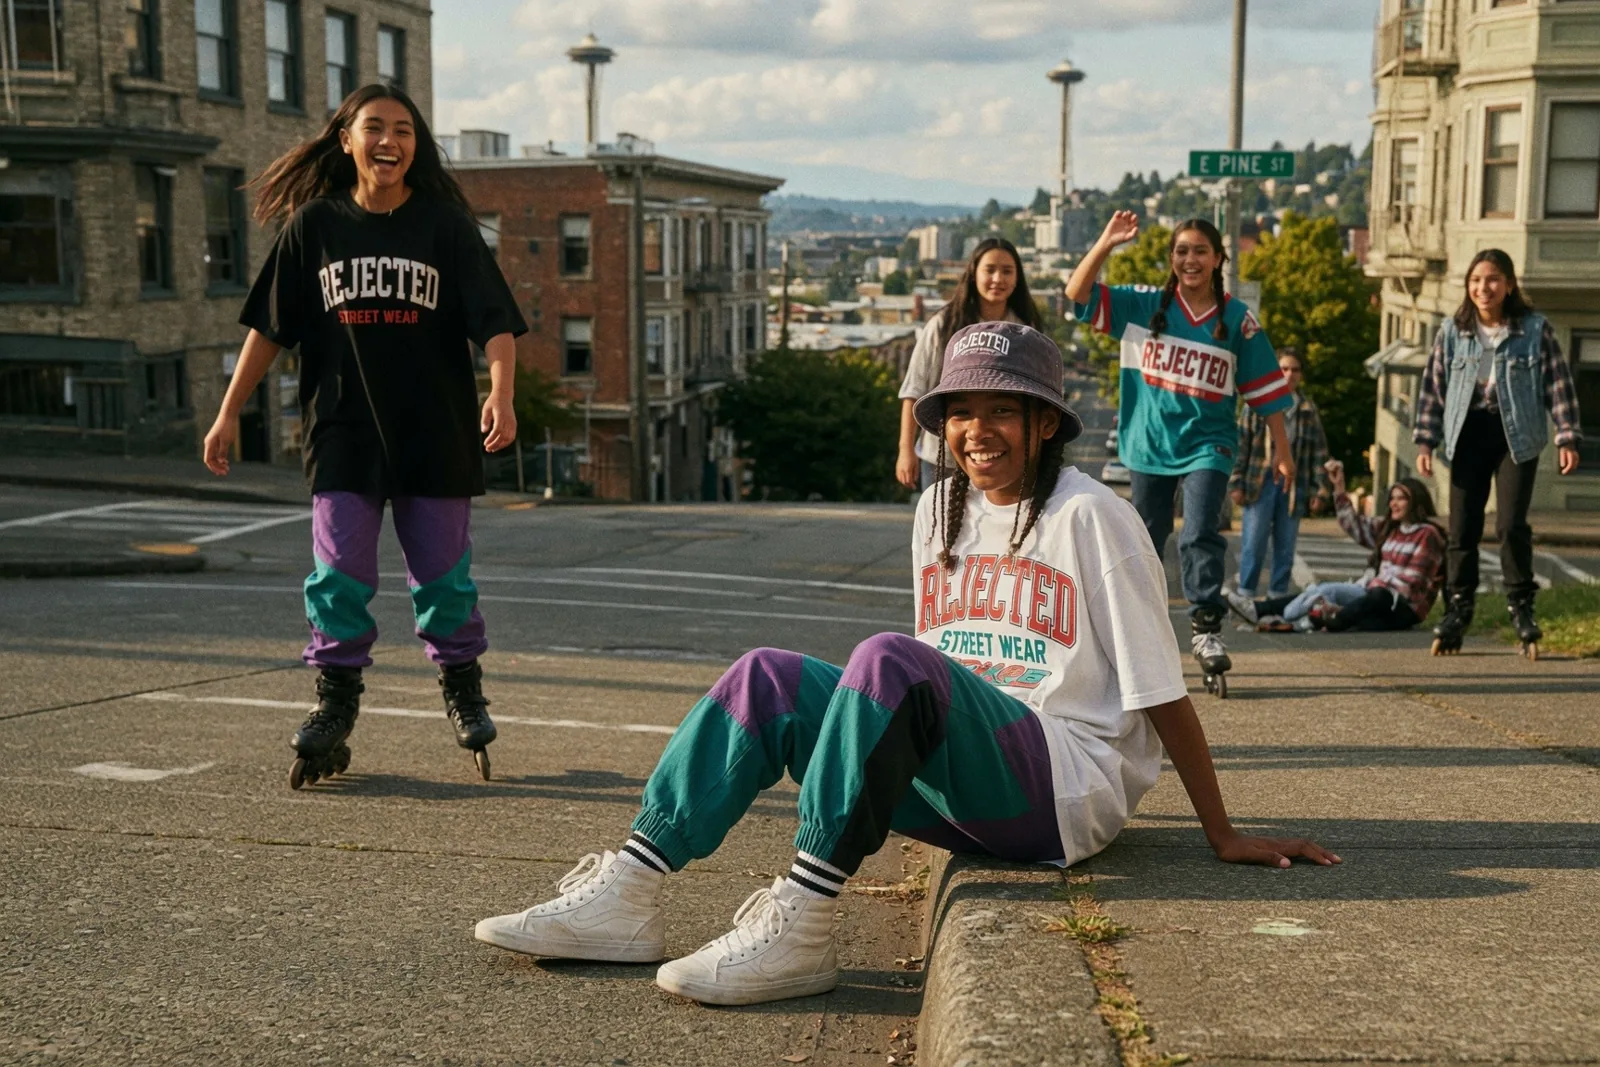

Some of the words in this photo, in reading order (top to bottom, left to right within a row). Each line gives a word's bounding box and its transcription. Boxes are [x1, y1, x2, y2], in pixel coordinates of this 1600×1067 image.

[1200, 155, 1210, 174] E
[1219, 154, 1262, 174] PINE
[1270, 156, 1285, 172] ST
[318, 256, 440, 313] REJECTED
[338, 309, 379, 324] STREET
[383, 309, 419, 324] WEAR
[951, 331, 1010, 361] REJECTED
[1141, 341, 1229, 389] REJECTED
[916, 554, 1078, 649] REJECTED
[937, 630, 993, 657] STREET
[998, 634, 1047, 665] WEAR
